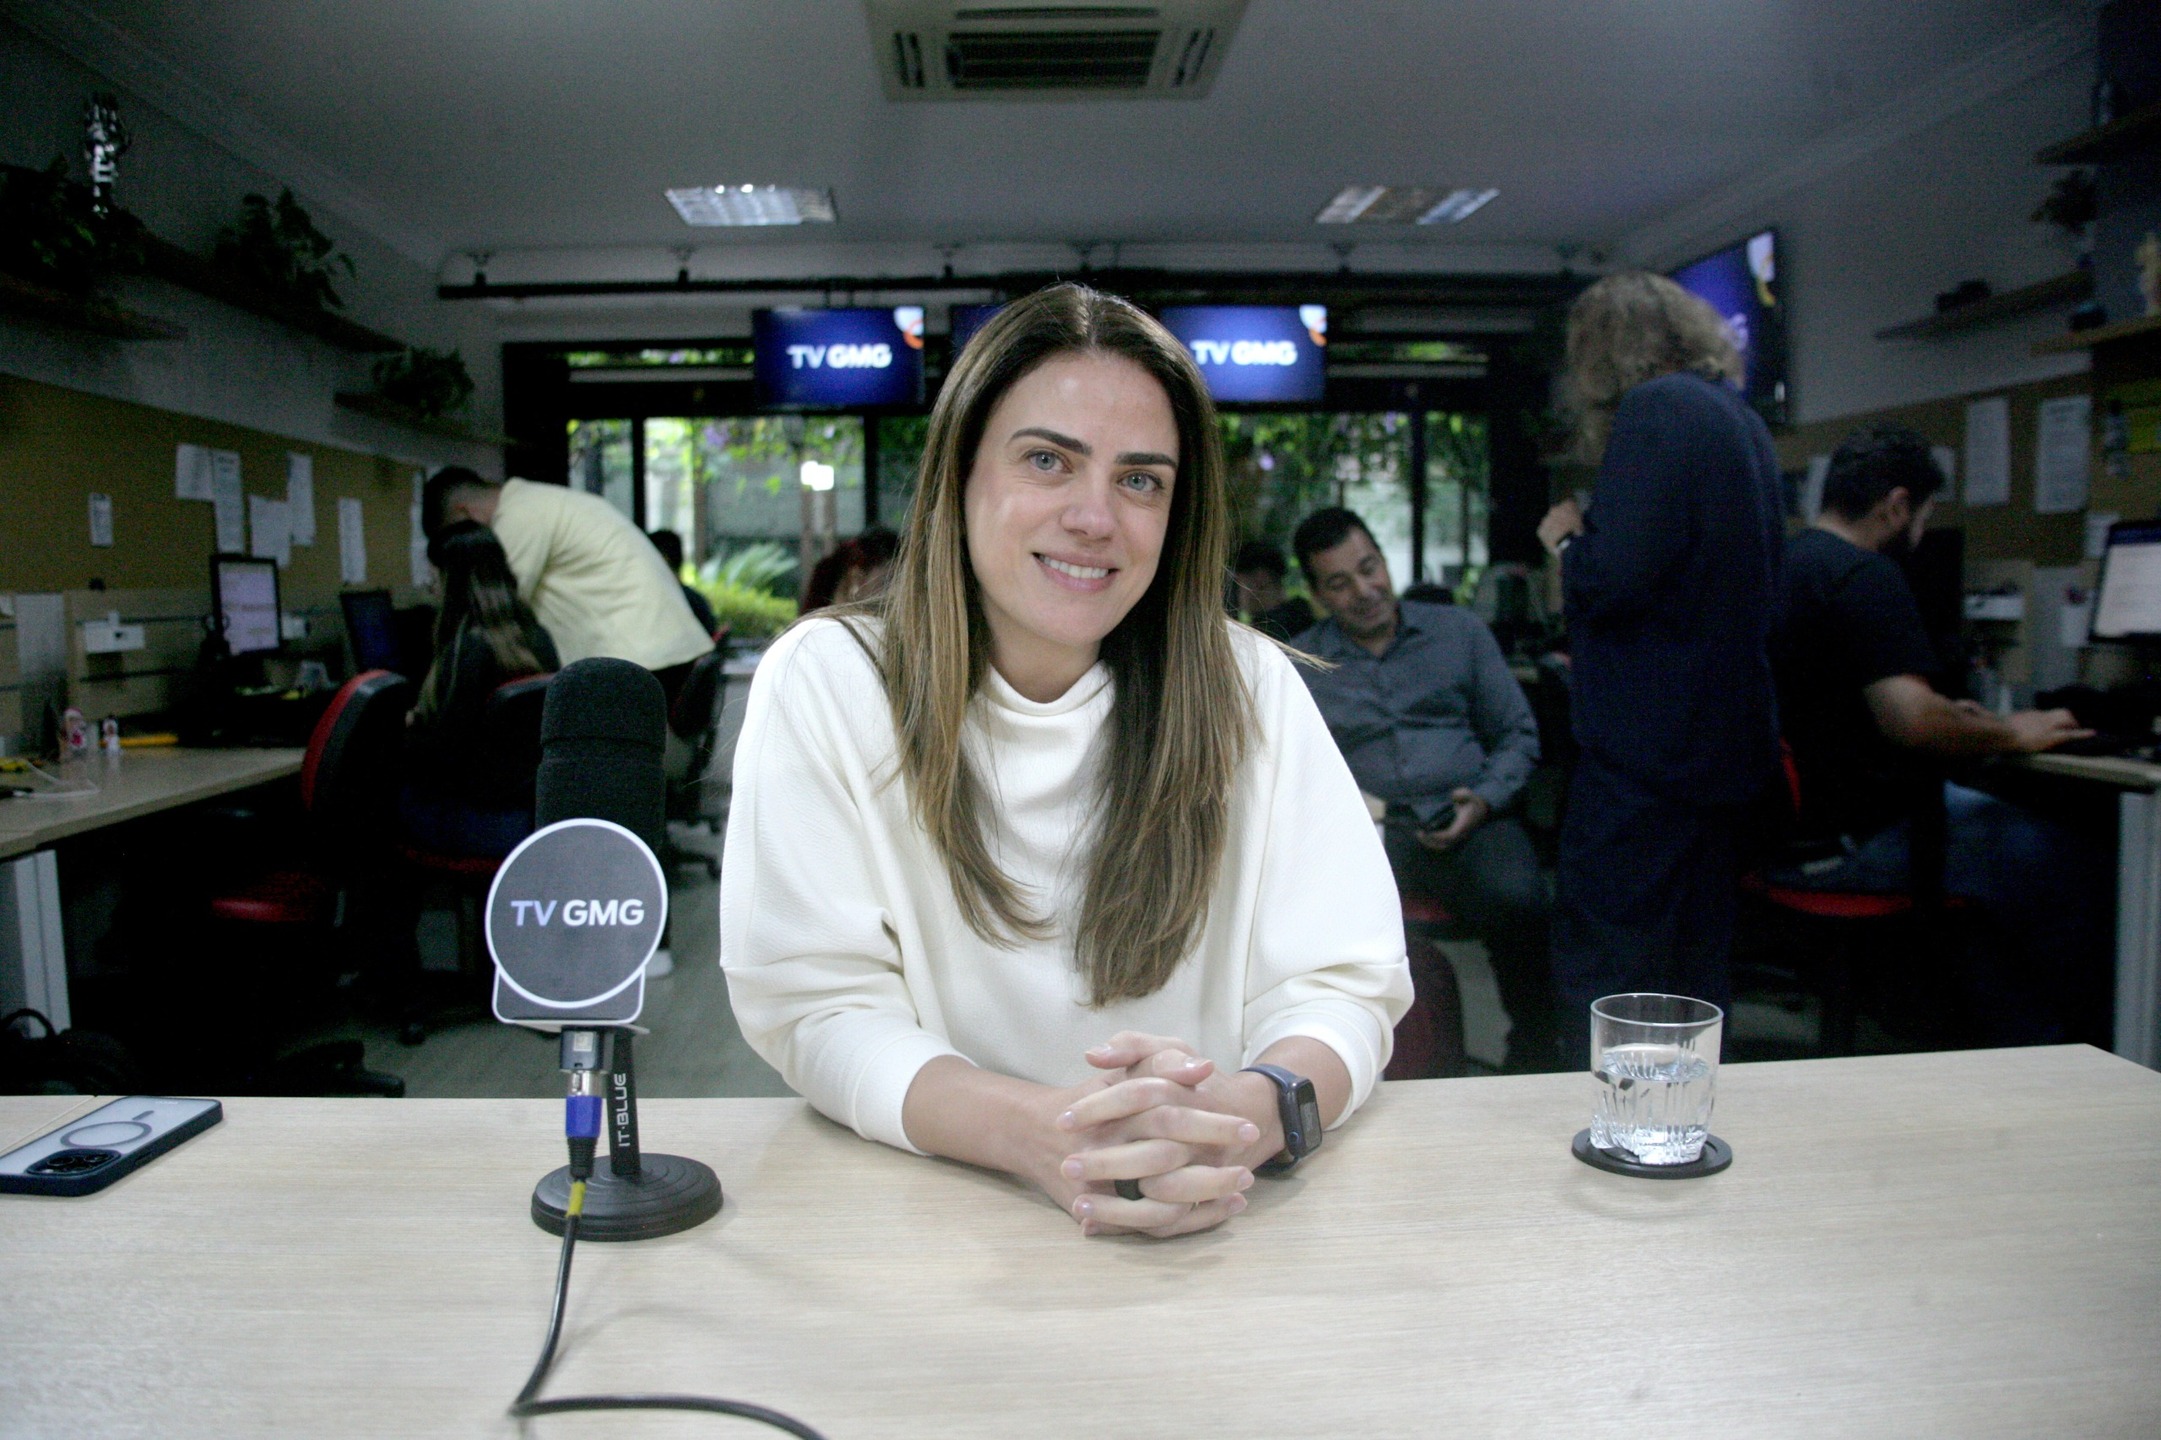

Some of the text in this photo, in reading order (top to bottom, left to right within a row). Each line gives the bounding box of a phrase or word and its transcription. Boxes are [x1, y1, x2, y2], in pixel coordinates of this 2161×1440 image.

[786, 343, 893, 369] TV GMG
[1190, 340, 1298, 366] TV GMG
[510, 898, 645, 927] TV GMG
